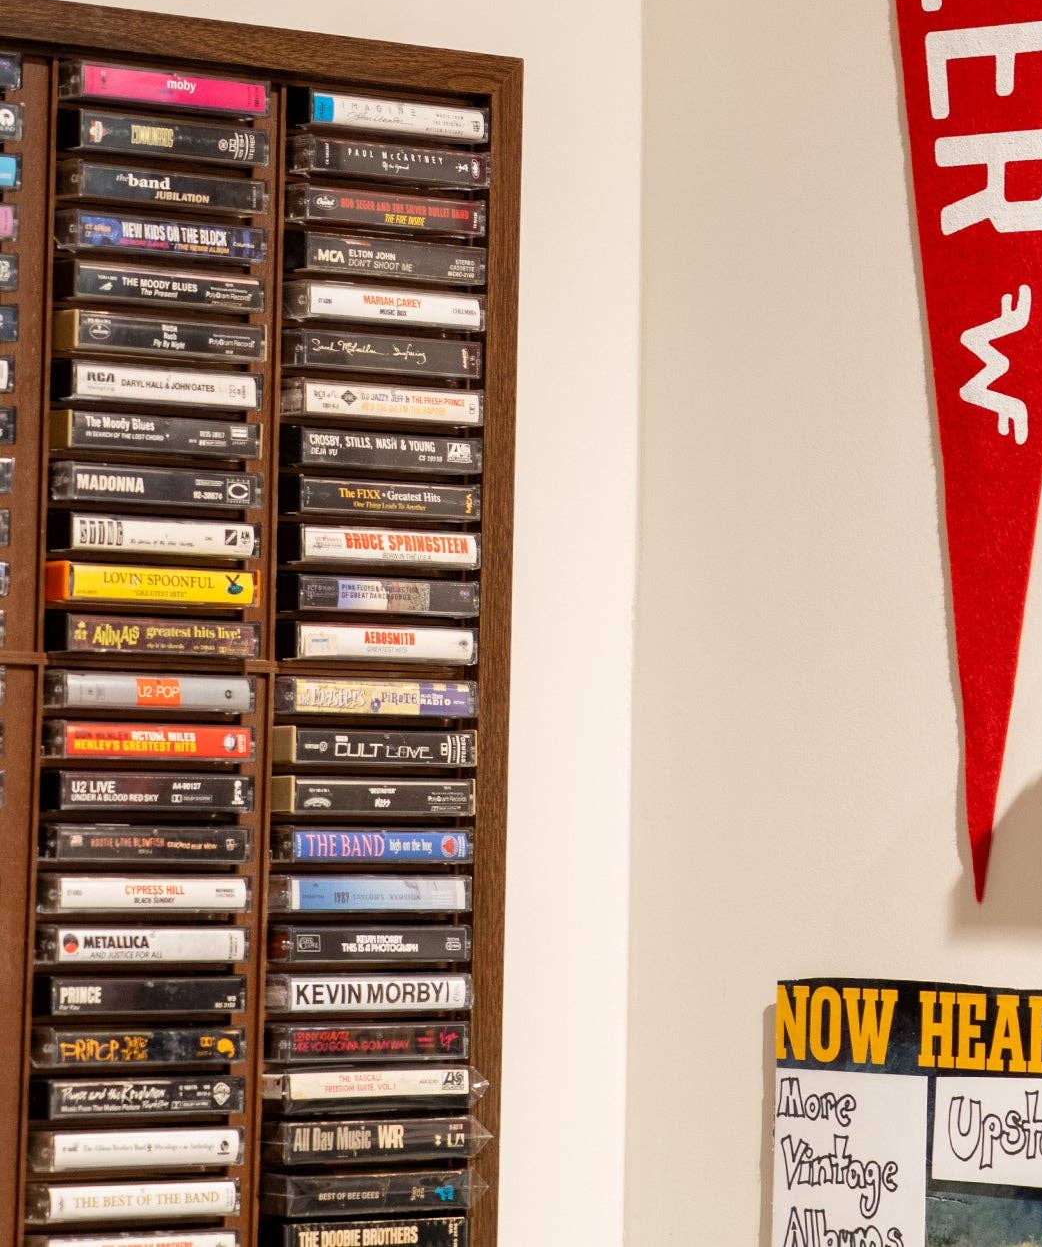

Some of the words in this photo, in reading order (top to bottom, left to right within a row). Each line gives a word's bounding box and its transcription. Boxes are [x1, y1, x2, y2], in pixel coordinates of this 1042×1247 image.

[167, 79, 196, 93] moby
[348, 148, 374, 158] PAUL
[382, 151, 443, 165] McCARTNEY
[128, 174, 171, 190] band
[155, 191, 209, 203] JUBILATION
[356, 201, 375, 210] SEGER
[377, 203, 391, 212] AND
[407, 205, 427, 215] SILVER
[428, 206, 450, 218] BULLET
[452, 209, 469, 220] BAND
[385, 213, 395, 224] THE
[396, 214, 407, 225] FIRE
[408, 215, 425, 226] INSIDE
[122, 221, 143, 240] NEW
[144, 223, 166, 241] KIDS
[167, 226, 180, 243] ON
[182, 227, 199, 244] THE
[200, 229, 228, 247] BLOCK
[317, 249, 345, 263] MCA
[349, 249, 373, 259] ELTON
[375, 251, 396, 261] JOHN
[348, 258, 373, 268] DON'T
[374, 261, 401, 271] SHOOT
[402, 263, 413, 273] ME
[449, 264, 475, 272] CASSETTE
[122, 277, 138, 288] THE
[140, 278, 170, 290] MOODY
[172, 282, 198, 293] BLUES
[364, 295, 395, 306] MARIAH
[396, 297, 422, 308] CAREY
[380, 307, 396, 317] MUSIC
[397, 309, 407, 317] BOX
[87, 371, 115, 383] RCA
[121, 378, 144, 388] DARYL
[146, 379, 164, 389] HALL
[171, 381, 190, 391] JOHN
[189, 383, 215, 393] OATES
[85, 416, 101, 428] The
[103, 417, 130, 432] Moody
[132, 418, 155, 432] Blues
[310, 434, 342, 448] CROSBY,
[345, 436, 373, 450] STILLS,
[376, 438, 397, 450] NASH
[400, 439, 406, 450] &
[409, 440, 435, 453] YOUNG
[76, 474, 144, 494] MADONNA
[338, 487, 356, 499] The
[357, 488, 381, 499] FIXX
[387, 491, 421, 502] Greatest
[424, 492, 441, 503] Hits
[344, 532, 385, 551] BRUCE
[388, 535, 468, 554] SPRINGSTEEN
[147, 573, 214, 589] SPOONFUL
[92, 624, 140, 650] ANIMALS
[146, 626, 191, 640] greatest
[194, 626, 215, 638] hits
[218, 627, 241, 640] live!
[364, 631, 415, 645] AEROSMITH
[138, 685, 153, 698] U2
[156, 687, 180, 699] POP
[131, 731, 166, 742] ACTUAL
[168, 732, 196, 742] MILES
[74, 739, 120, 750] HENLEY'S
[123, 740, 171, 752] GREATEST
[174, 741, 196, 753] HITS
[334, 743, 383, 757] CULT
[386, 746, 433, 759] LOVE
[71, 780, 87, 793] U2
[90, 780, 115, 794] LIVE
[71, 793, 95, 802] UNDER
[96, 794, 103, 802] A
[103, 793, 128, 802] BLOOD
[129, 794, 143, 802] RED
[144, 794, 159, 803] SKY
[305, 834, 337, 857] THE
[341, 834, 385, 857] BAND
[390, 839, 401, 854] high
[402, 841, 410, 851] on
[411, 840, 421, 851] the
[421, 839, 432, 854] hog
[125, 885, 164, 895] CYPRESS
[166, 886, 185, 895] HILL
[153, 897, 175, 905] SUNDAY
[83, 936, 149, 949] METALLICA
[356, 935, 379, 943] KEVIN
[379, 935, 403, 943] MORBY
[108, 951, 134, 959] JUSTICE
[135, 951, 150, 959] FOR
[151, 951, 163, 959] ALL
[60, 986, 102, 1005] PRINCE
[296, 983, 362, 1005] KEVIN
[367, 982, 444, 1004] MORBY
[777, 983, 899, 1066] NOW
[777, 1077, 857, 1127] More
[293, 1127, 309, 1152] All
[312, 1127, 334, 1151] Day
[336, 1126, 371, 1150] Music
[377, 1124, 404, 1149] WAR
[781, 1133, 899, 1219] Vintage
[73, 1197, 98, 1209] THE
[103, 1195, 132, 1208] BEST
[137, 1194, 150, 1207] OF
[157, 1193, 182, 1204] THE
[185, 1191, 219, 1203] BAND
[318, 1193, 336, 1201] BEST
[337, 1192, 346, 1200] OF
[347, 1192, 361, 1200] BEE
[361, 1191, 379, 1200] GEES
[782, 1206, 905, 1247] Albums
[298, 1232, 319, 1247] THE
[321, 1229, 361, 1247] DOOBIE
[363, 1225, 418, 1246] BROTHERS
